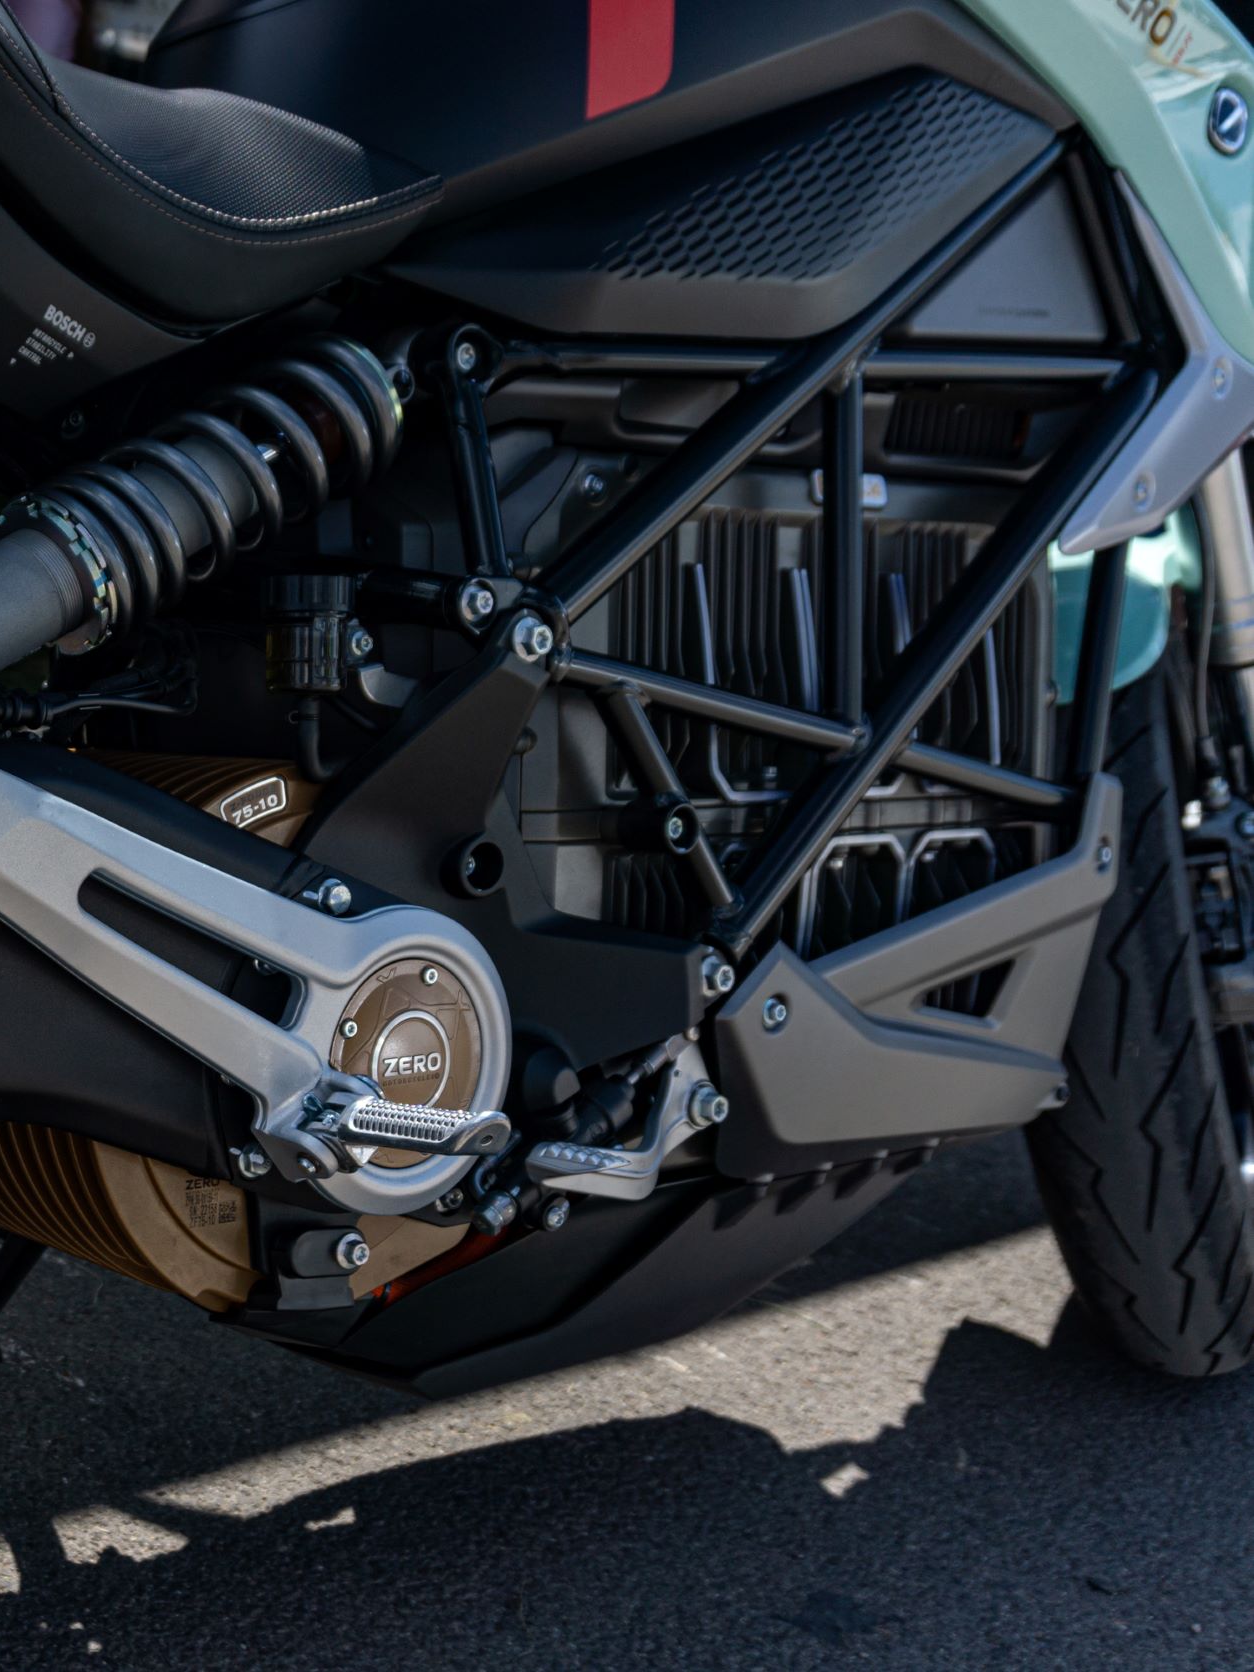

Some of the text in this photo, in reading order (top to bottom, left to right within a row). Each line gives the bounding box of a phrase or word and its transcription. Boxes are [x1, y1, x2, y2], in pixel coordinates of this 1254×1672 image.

[44, 304, 87, 342] BOSCH
[232, 794, 278, 824] 75-10
[384, 1052, 441, 1077] ZERO
[186, 1176, 220, 1190] ZERO
